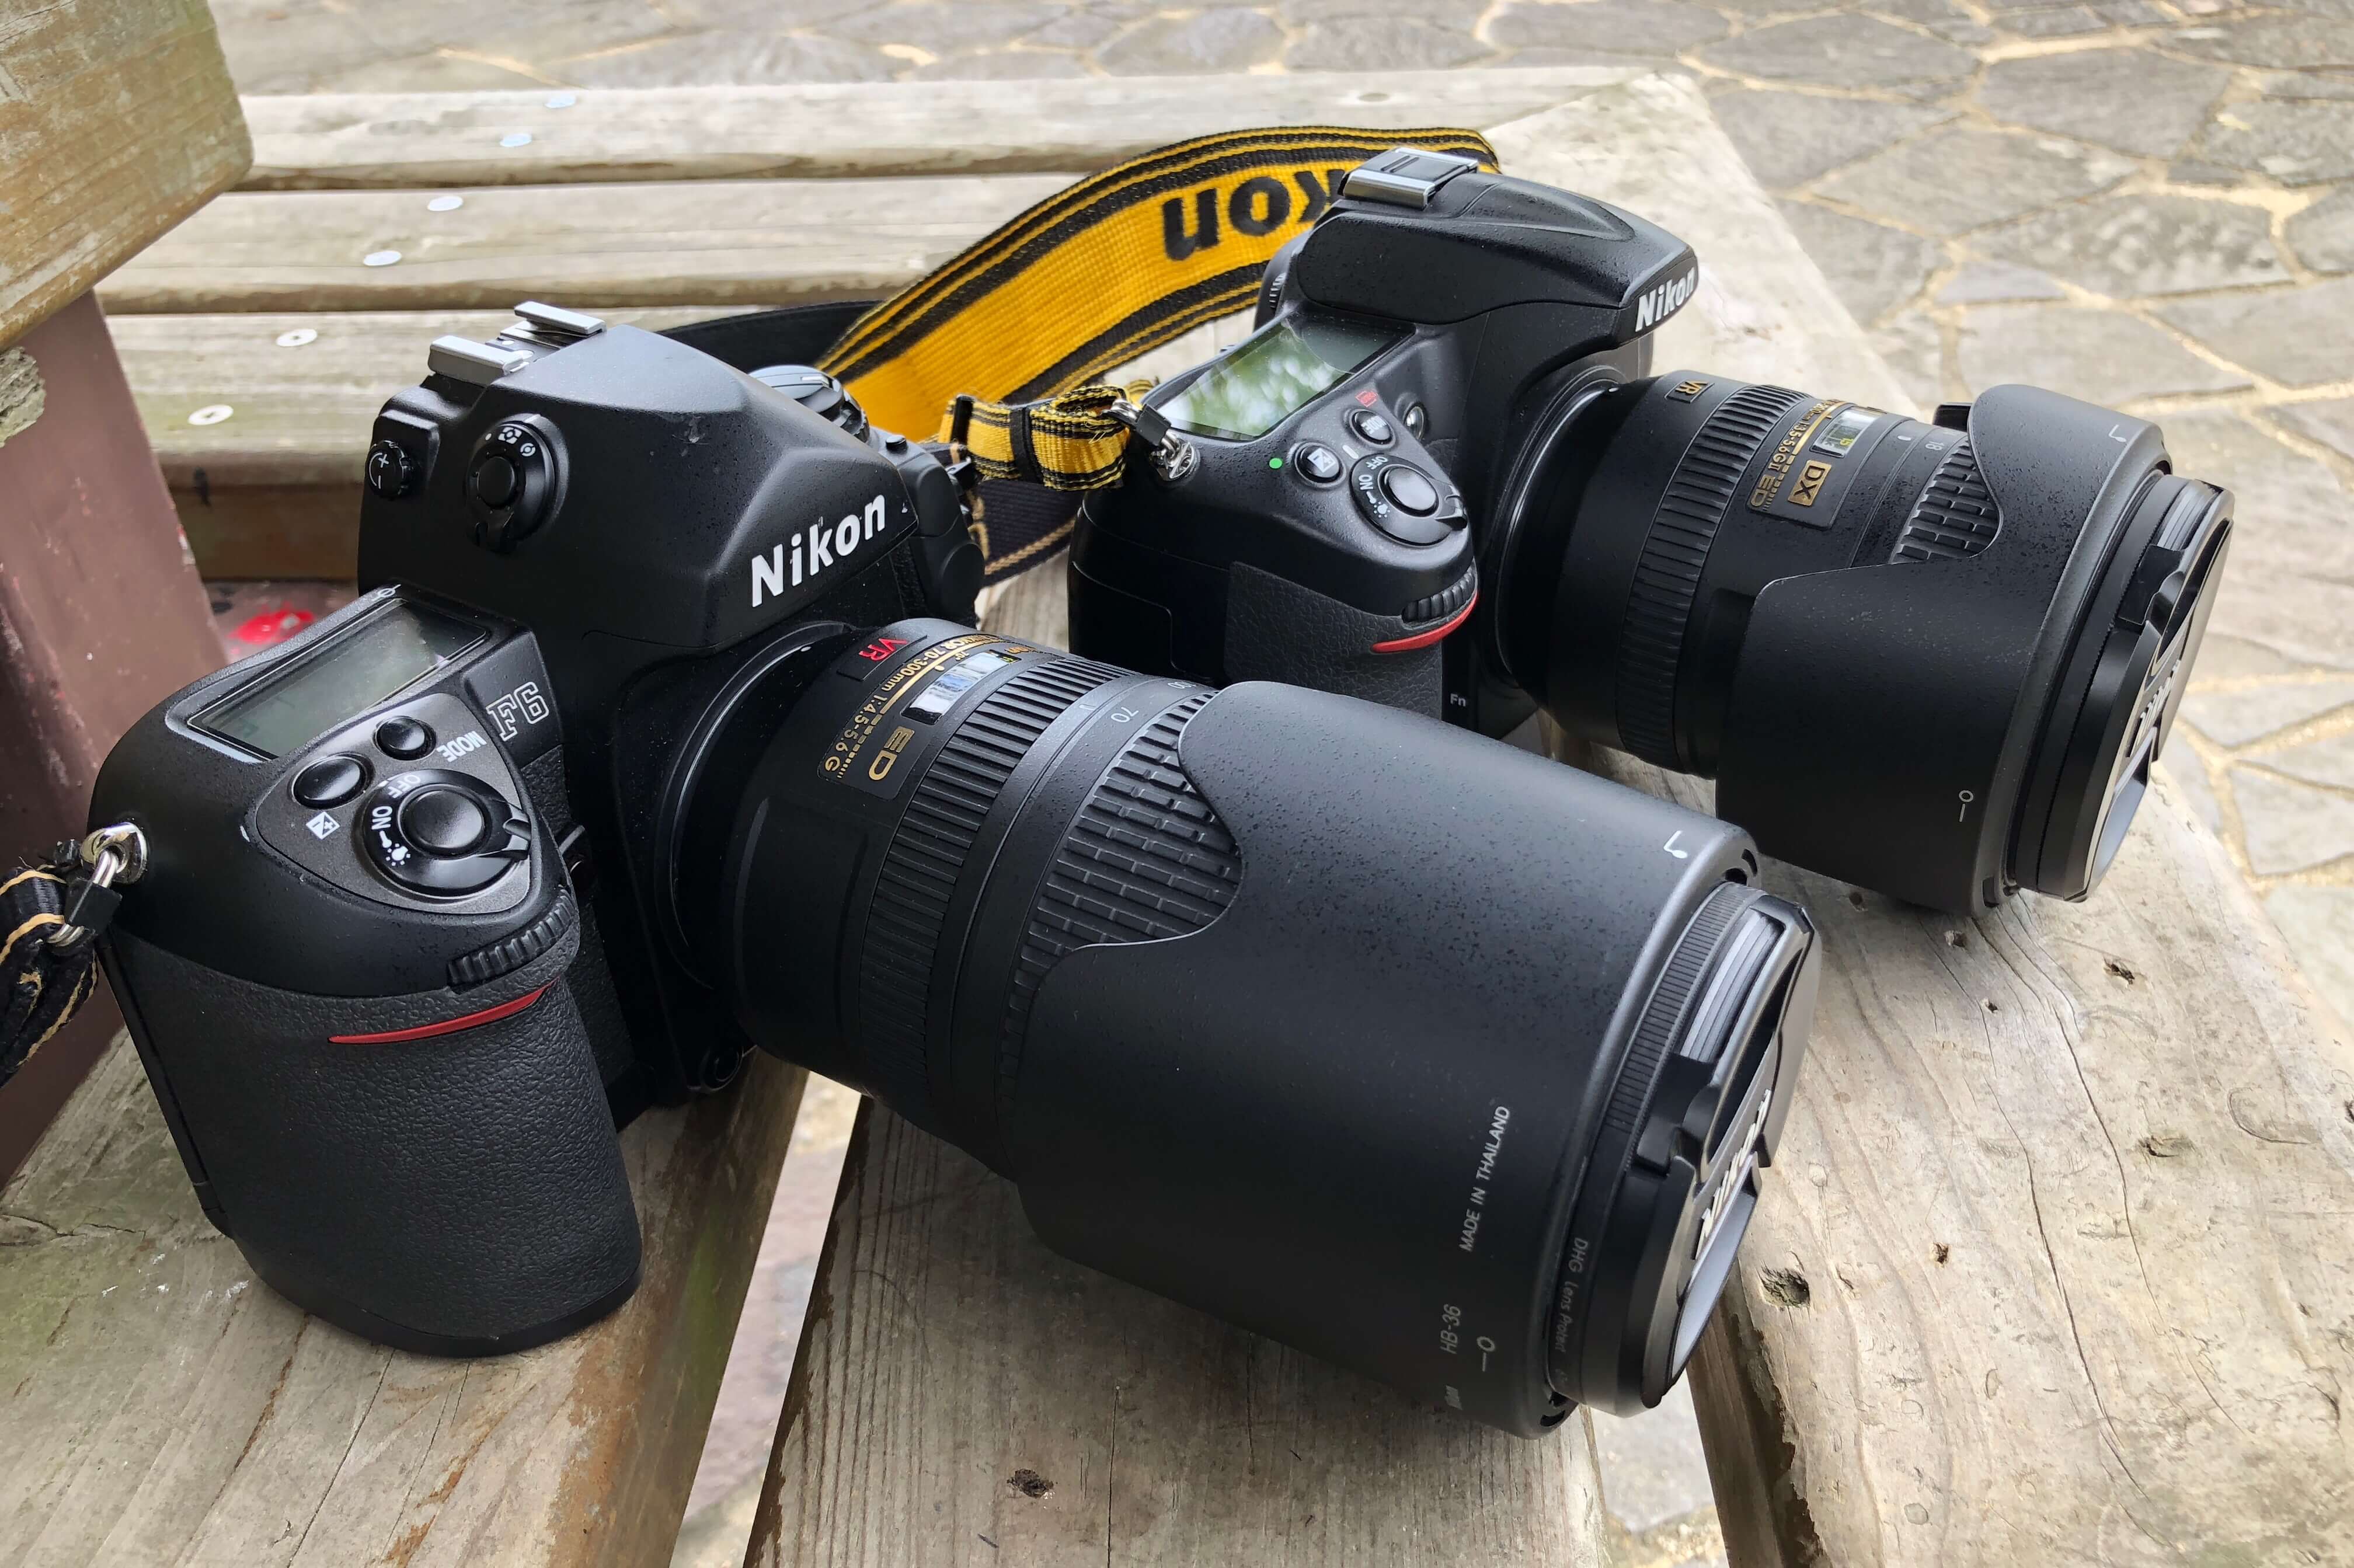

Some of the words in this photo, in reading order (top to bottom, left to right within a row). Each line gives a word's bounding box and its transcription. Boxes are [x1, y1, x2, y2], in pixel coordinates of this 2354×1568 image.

[1635, 267, 1695, 332] Nikon
[1675, 381, 1709, 395] VR
[1925, 441, 1945, 451] 18
[1366, 456, 1389, 471] OFF
[1358, 474, 1374, 490] ON
[1751, 474, 1776, 507] ED
[1793, 465, 1826, 501] DX
[751, 494, 886, 608] Nikon
[859, 637, 909, 661] VR
[881, 647, 947, 692] 70-300mm
[486, 681, 549, 742] F6
[1110, 706, 1139, 723] 70
[1450, 693, 1467, 707] Fn
[436, 730, 487, 762] MODE
[868, 726, 915, 781] ED
[824, 755, 841, 771] G
[387, 773, 422, 799] OFF
[371, 806, 393, 830] ON
[1476, 1106, 1511, 1182] THAILAND
[1470, 1187, 1486, 1205] IN
[1460, 1209, 1482, 1252] MADE
[1568, 1237, 1589, 1273] DHG
[1440, 1304, 1461, 1355] HB-36
